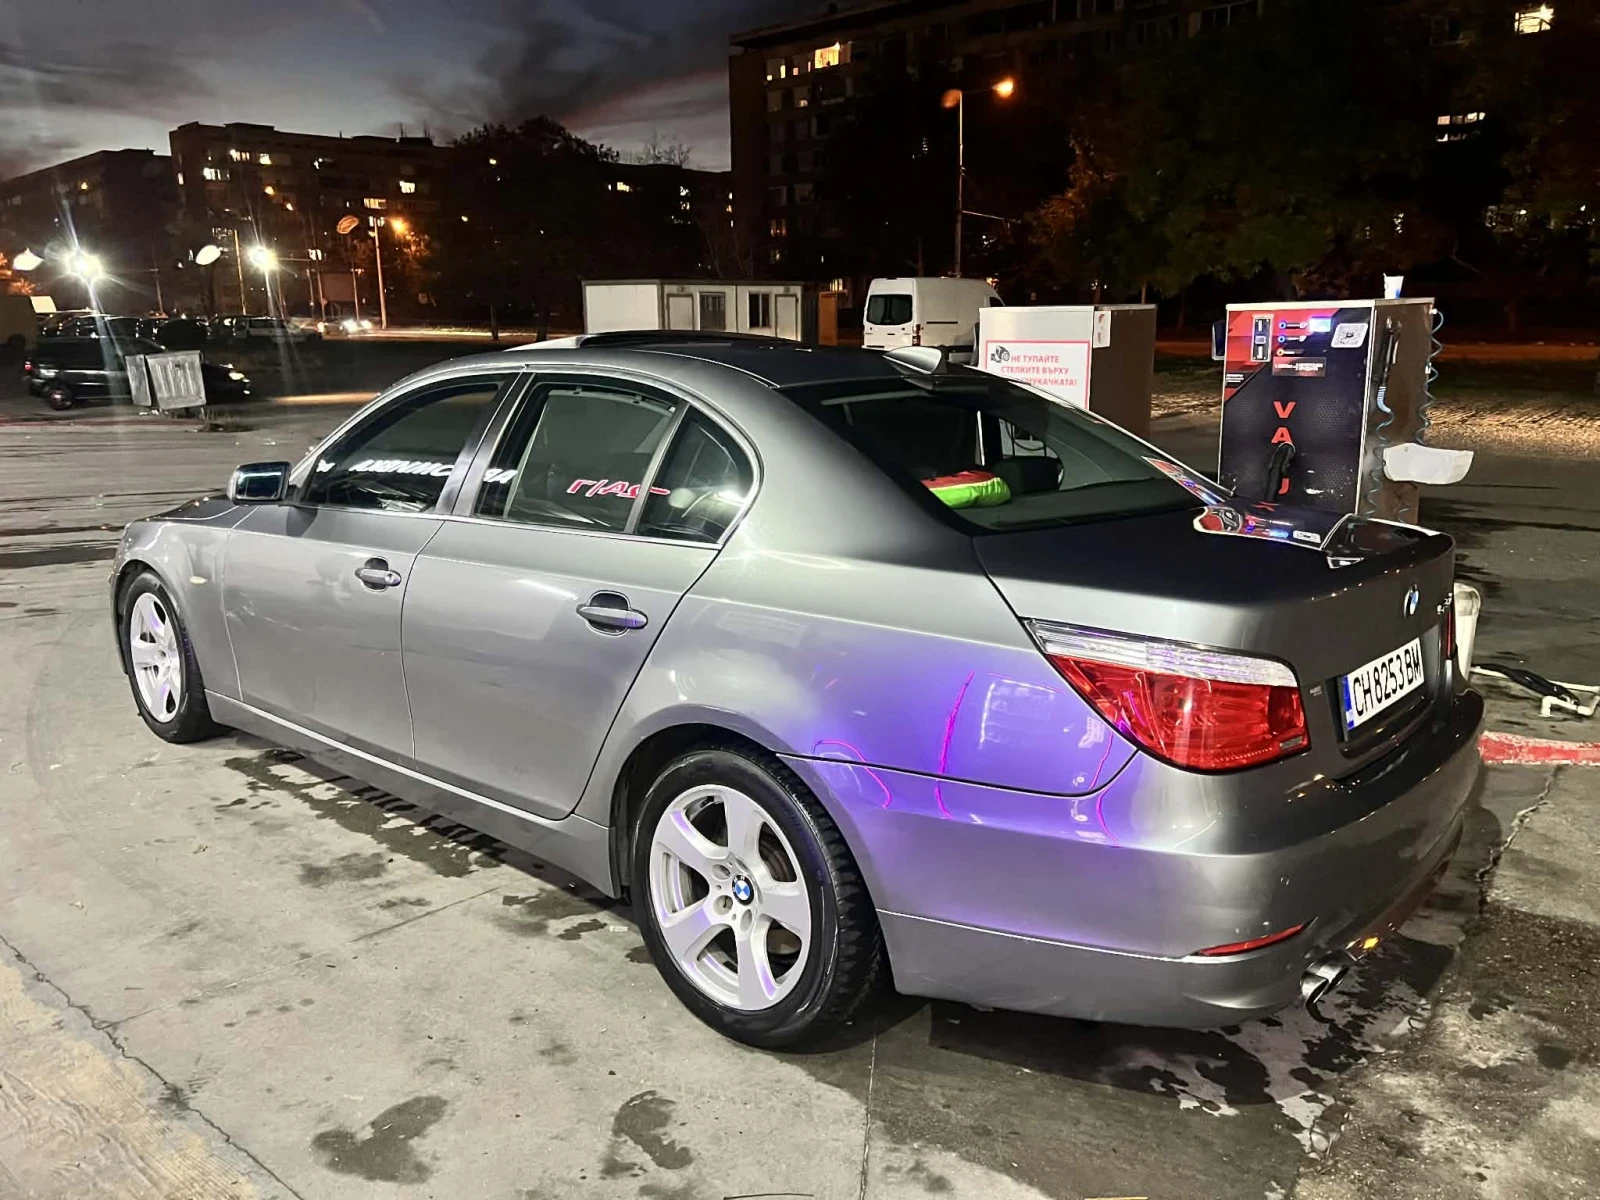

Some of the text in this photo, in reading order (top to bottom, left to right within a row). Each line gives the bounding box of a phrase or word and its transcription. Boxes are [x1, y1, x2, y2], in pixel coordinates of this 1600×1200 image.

[1011, 354, 1060, 363] НЕ ТУПАЙТЕ
[1000, 366, 1070, 375] СТЕЛКИТЕ ВЪРХУ
[1353, 644, 1422, 716] CH 8253 BM
